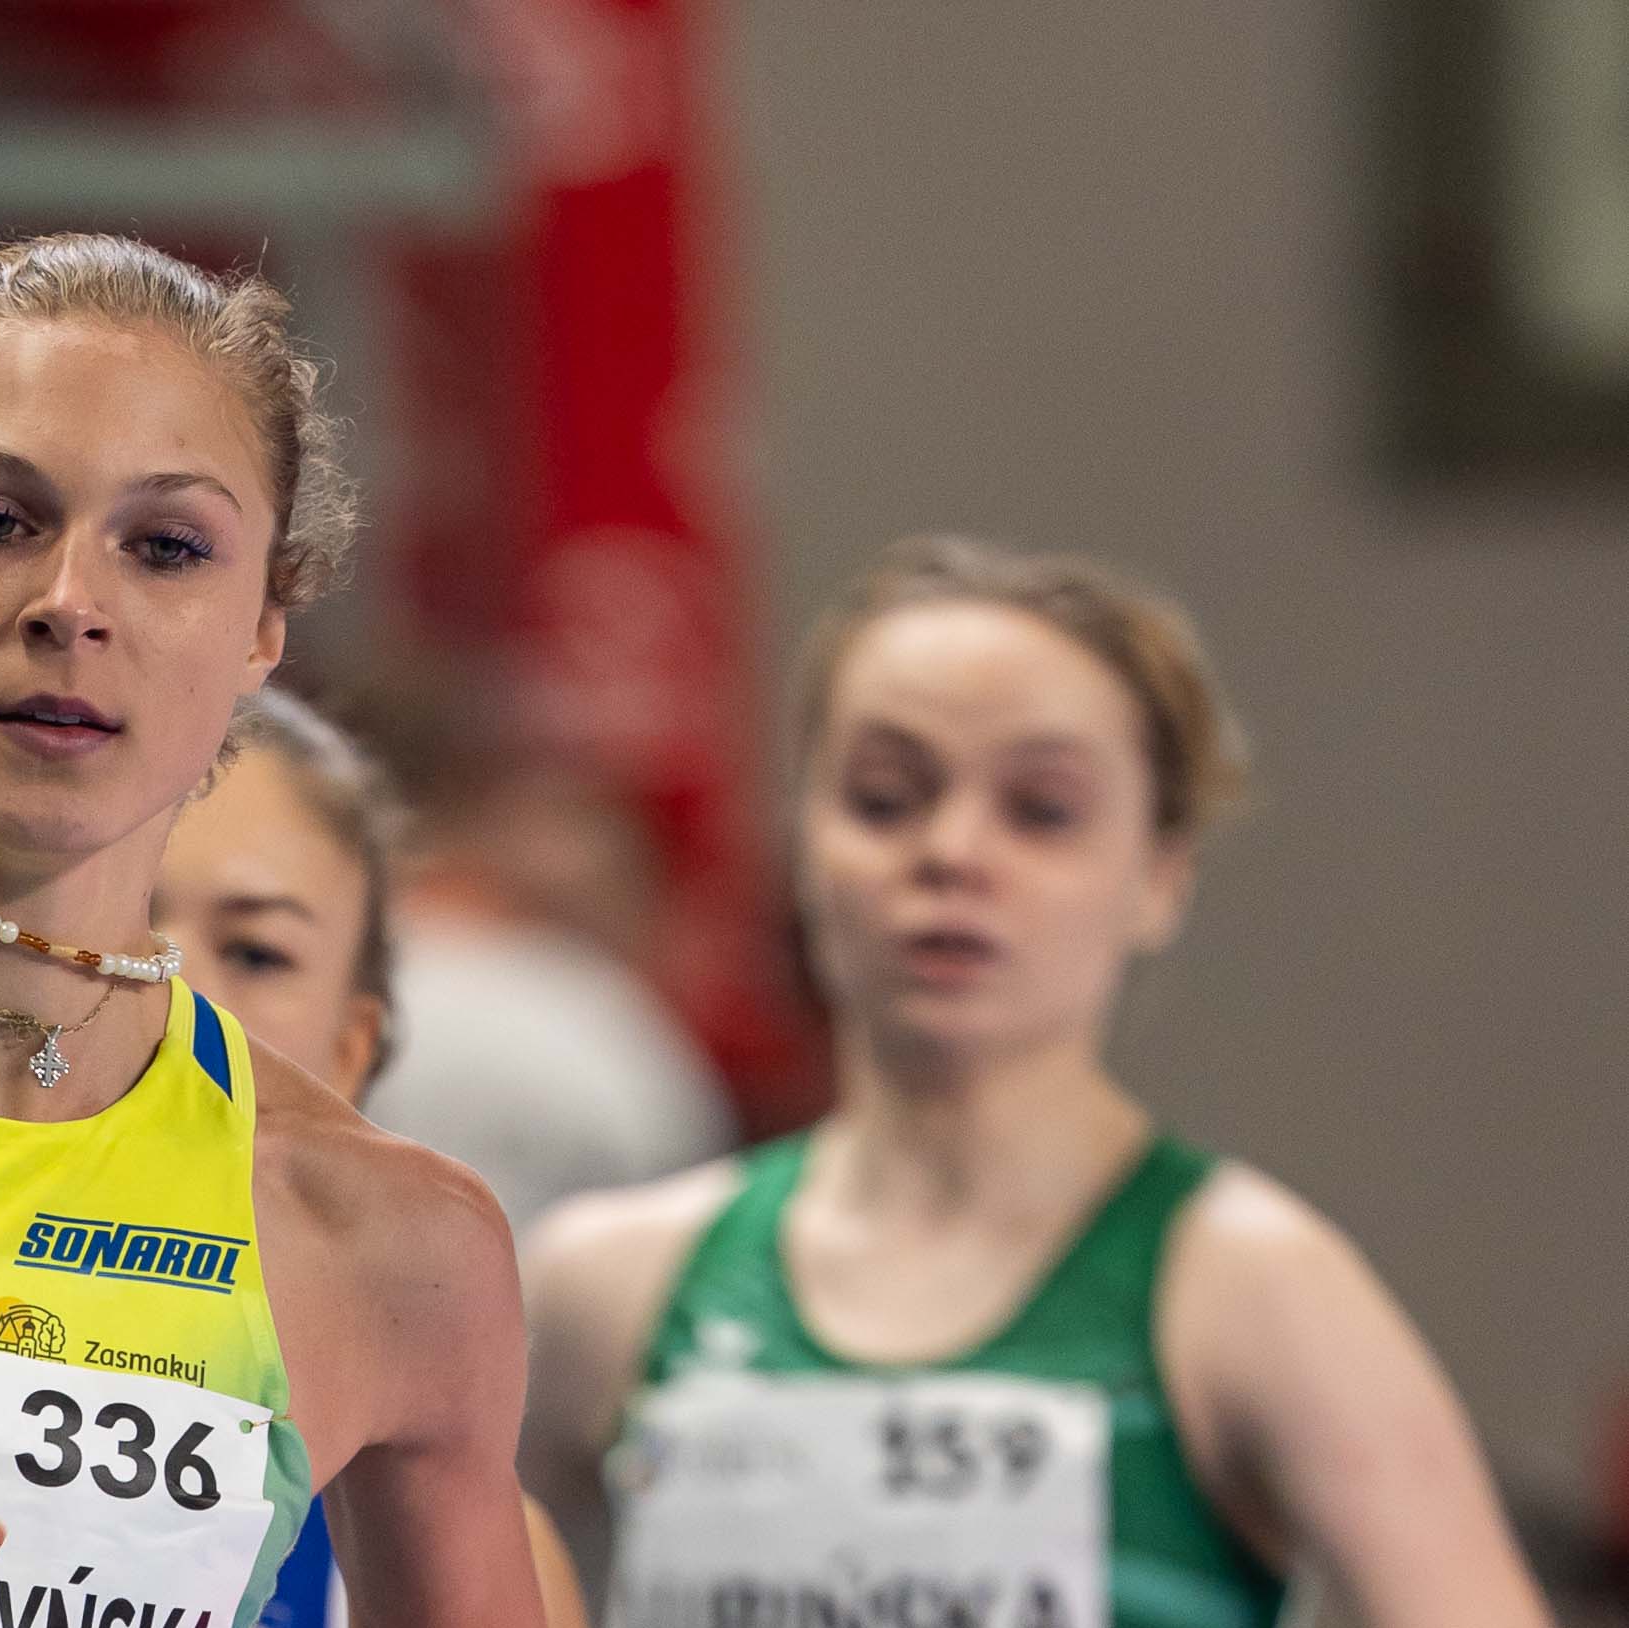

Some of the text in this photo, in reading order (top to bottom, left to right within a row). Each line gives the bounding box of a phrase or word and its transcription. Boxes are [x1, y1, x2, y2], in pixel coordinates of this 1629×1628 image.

[15, 1213, 248, 1293] SONAROL
[83, 1340, 207, 1387] Zasmakuj
[14, 1389, 222, 1510] 336
